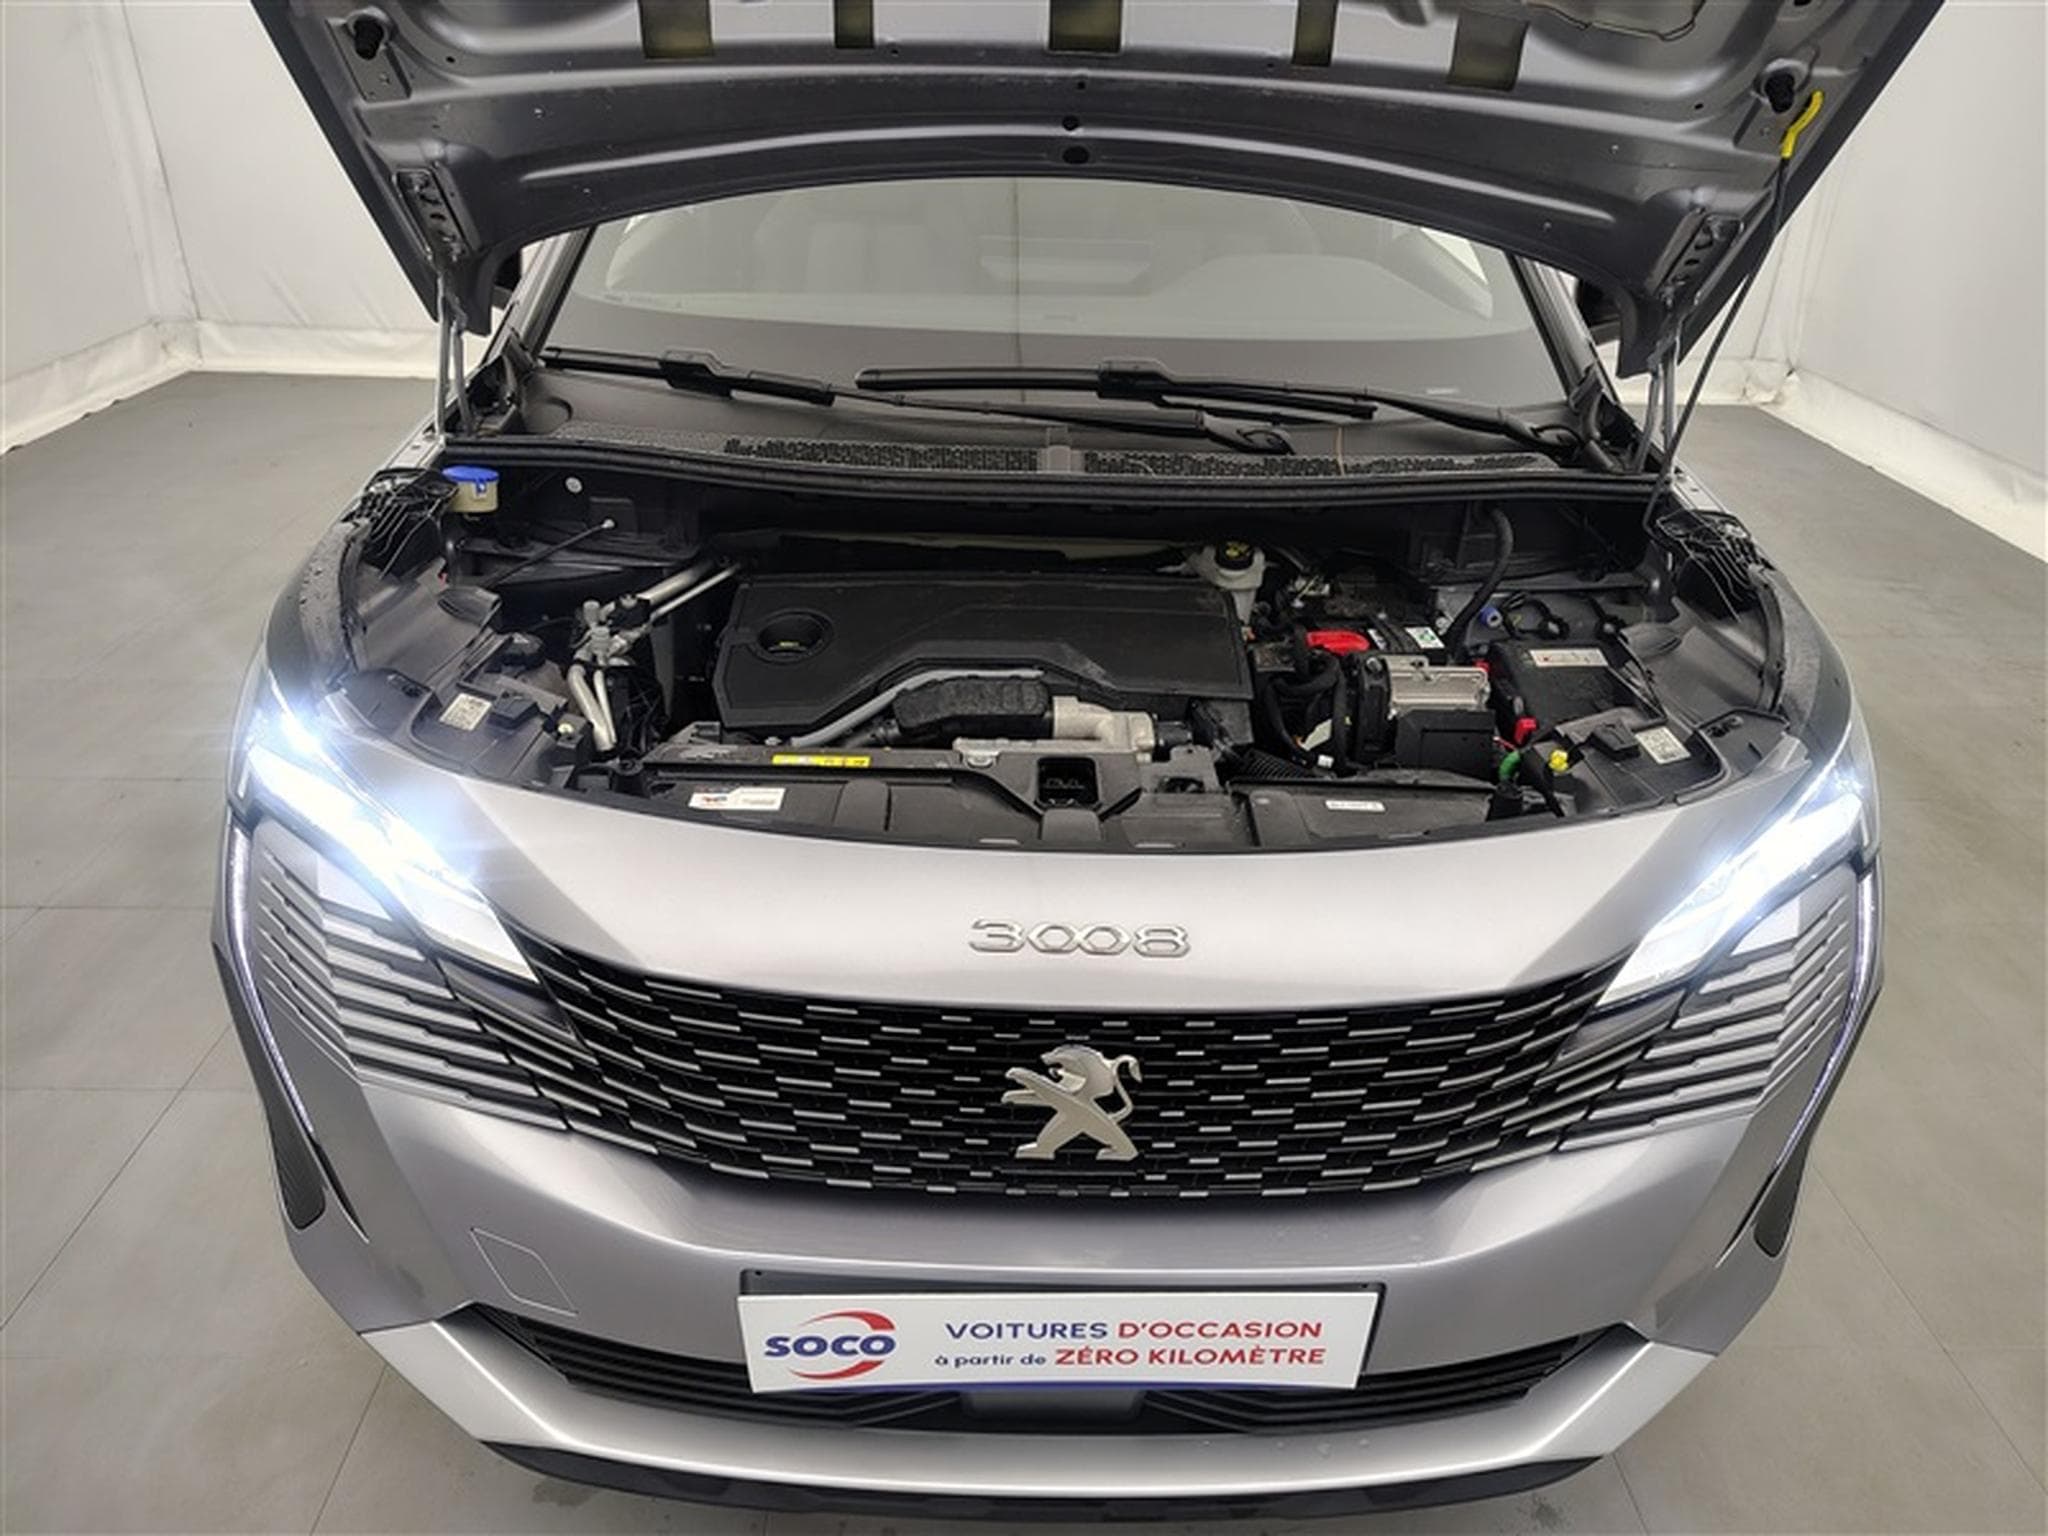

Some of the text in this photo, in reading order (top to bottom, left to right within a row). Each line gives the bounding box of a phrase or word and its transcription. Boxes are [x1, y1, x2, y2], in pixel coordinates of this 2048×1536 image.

[969, 919, 1191, 958] 3008
[945, 1322, 1323, 1340] VOITURES D'OCCASION
[764, 1334, 896, 1358] SOCO
[954, 1353, 1014, 1370] partir
[1020, 1353, 1047, 1366] de
[1055, 1345, 1139, 1366] ZÉRO
[1148, 1345, 1327, 1365] KILOMÈTRE
